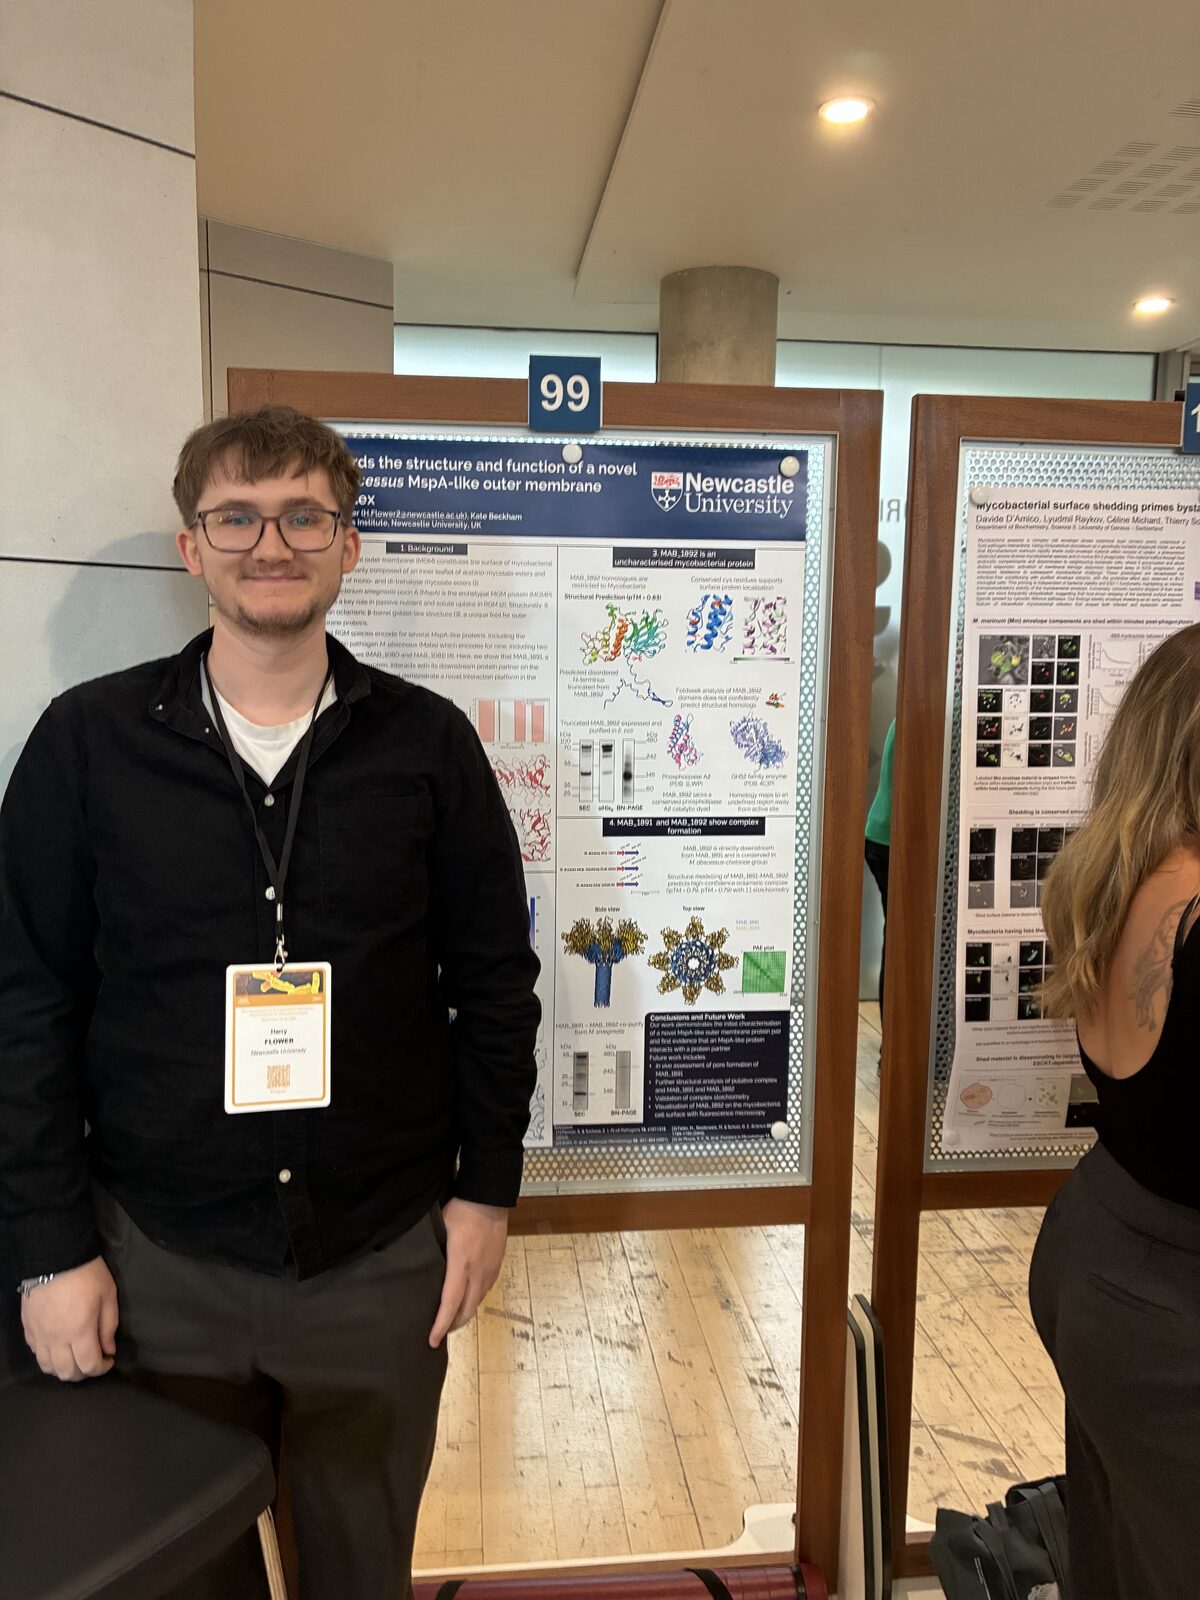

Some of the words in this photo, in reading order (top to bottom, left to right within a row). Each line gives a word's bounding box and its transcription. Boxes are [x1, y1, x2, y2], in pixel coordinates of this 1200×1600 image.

[540, 374, 590, 412] 99
[378, 456, 403, 470] the
[406, 456, 472, 471] structure
[476, 458, 502, 472] and
[506, 459, 565, 473] function
[569, 460, 584, 474] of
[586, 464, 595, 474] a
[598, 461, 637, 475] novel
[408, 475, 480, 493] MspA-like
[483, 477, 521, 491] outer
[526, 478, 602, 492] membrane
[686, 472, 794, 494] Newcastle
[684, 492, 793, 519] University
[1053, 501, 1090, 511] surface
[1093, 502, 1138, 514] shedding
[1141, 502, 1174, 514] primes
[489, 512, 522, 520] Beckham
[408, 545, 454, 554] Background
[660, 549, 698, 559] MAB_1892
[675, 559, 726, 569] mycobacterial
[727, 560, 754, 569] protein
[729, 818, 760, 828] complex
